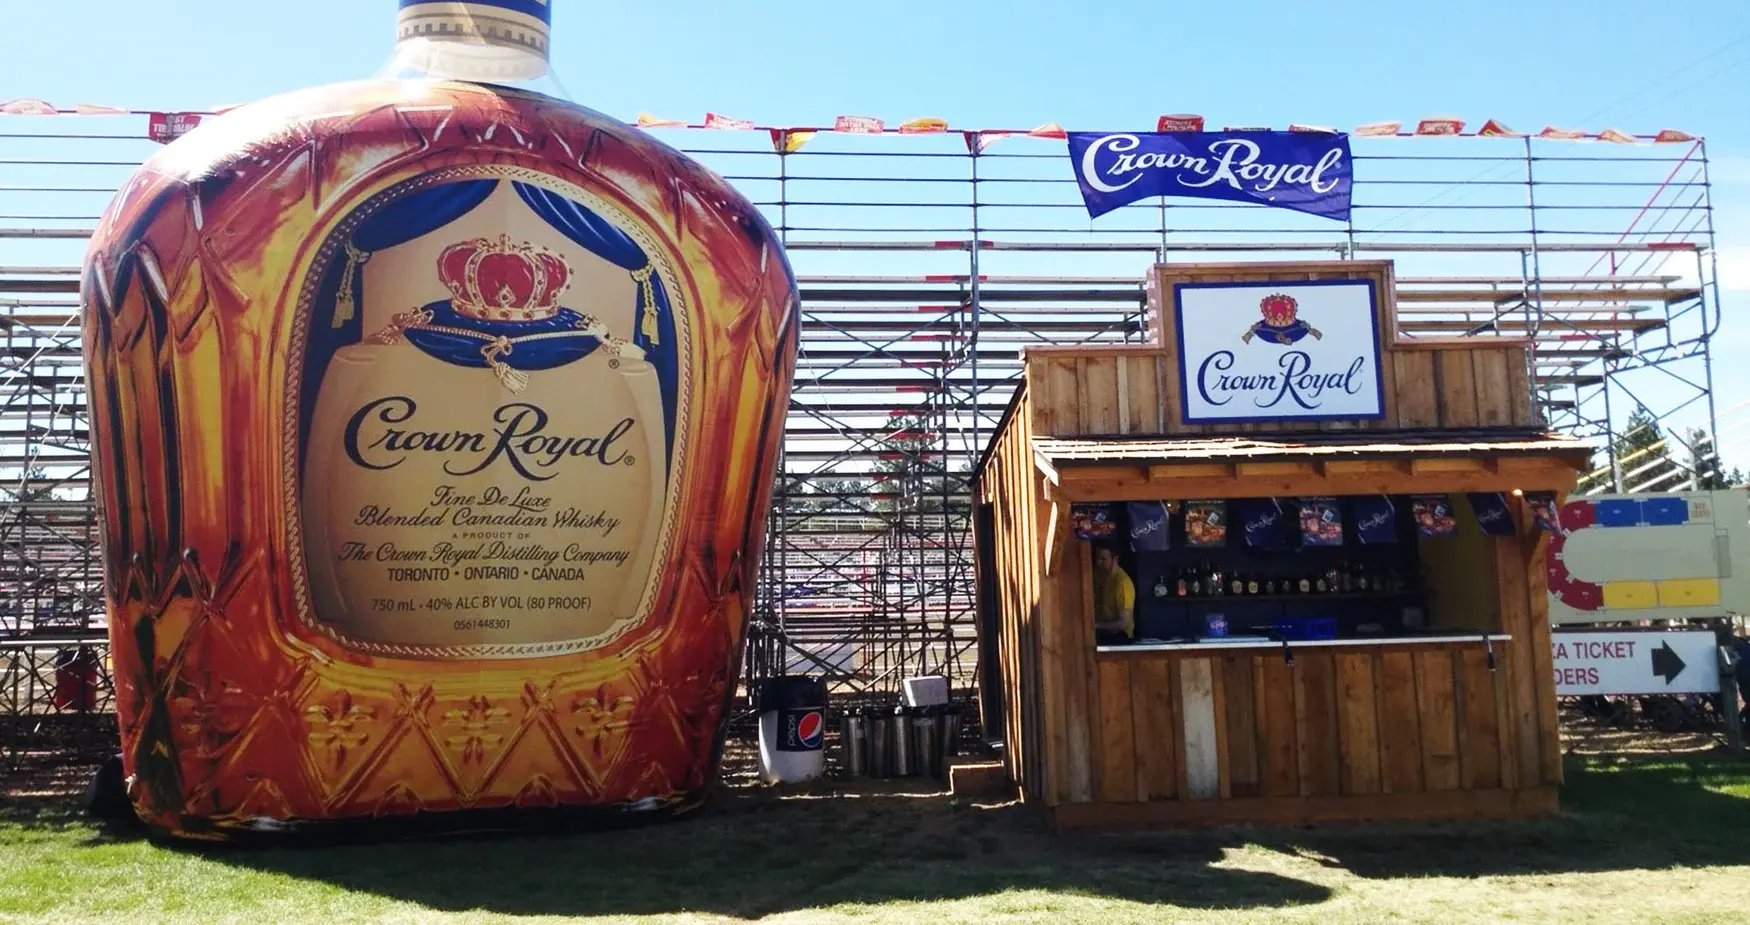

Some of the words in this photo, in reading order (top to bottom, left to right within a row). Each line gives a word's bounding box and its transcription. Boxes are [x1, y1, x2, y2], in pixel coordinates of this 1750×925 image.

[1081, 134, 1209, 193] Crown
[1177, 138, 1344, 201] Royal
[1197, 350, 1277, 406] Crown
[1254, 351, 1365, 410] Royal
[344, 396, 487, 471] Crown
[444, 403, 635, 482] Royal
[430, 485, 475, 507] Fine
[477, 486, 508, 507] De
[509, 486, 551, 512] Luxe
[354, 505, 448, 527] Blended
[452, 506, 548, 528] Canadian
[552, 507, 620, 537] Whisky
[452, 532, 459, 540] A
[463, 531, 512, 540] PRODUCT
[518, 531, 531, 540] OF
[338, 542, 373, 561] The
[376, 542, 427, 562] Crown
[429, 542, 482, 567] Royal
[482, 541, 560, 567] Distilling
[563, 543, 631, 567] Company
[387, 567, 450, 582] TORONTO
[464, 566, 519, 581] ONTARIO
[531, 566, 585, 582] CANADA
[371, 599, 395, 612] 750
[397, 598, 416, 612] mL
[426, 597, 452, 611] 40%
[455, 596, 481, 610] ALC
[482, 595, 498, 609] BY
[499, 595, 523, 609] VOL
[526, 596, 546, 611] (80
[548, 596, 592, 611] PROOF)
[1572, 641, 1636, 659] TICKET
